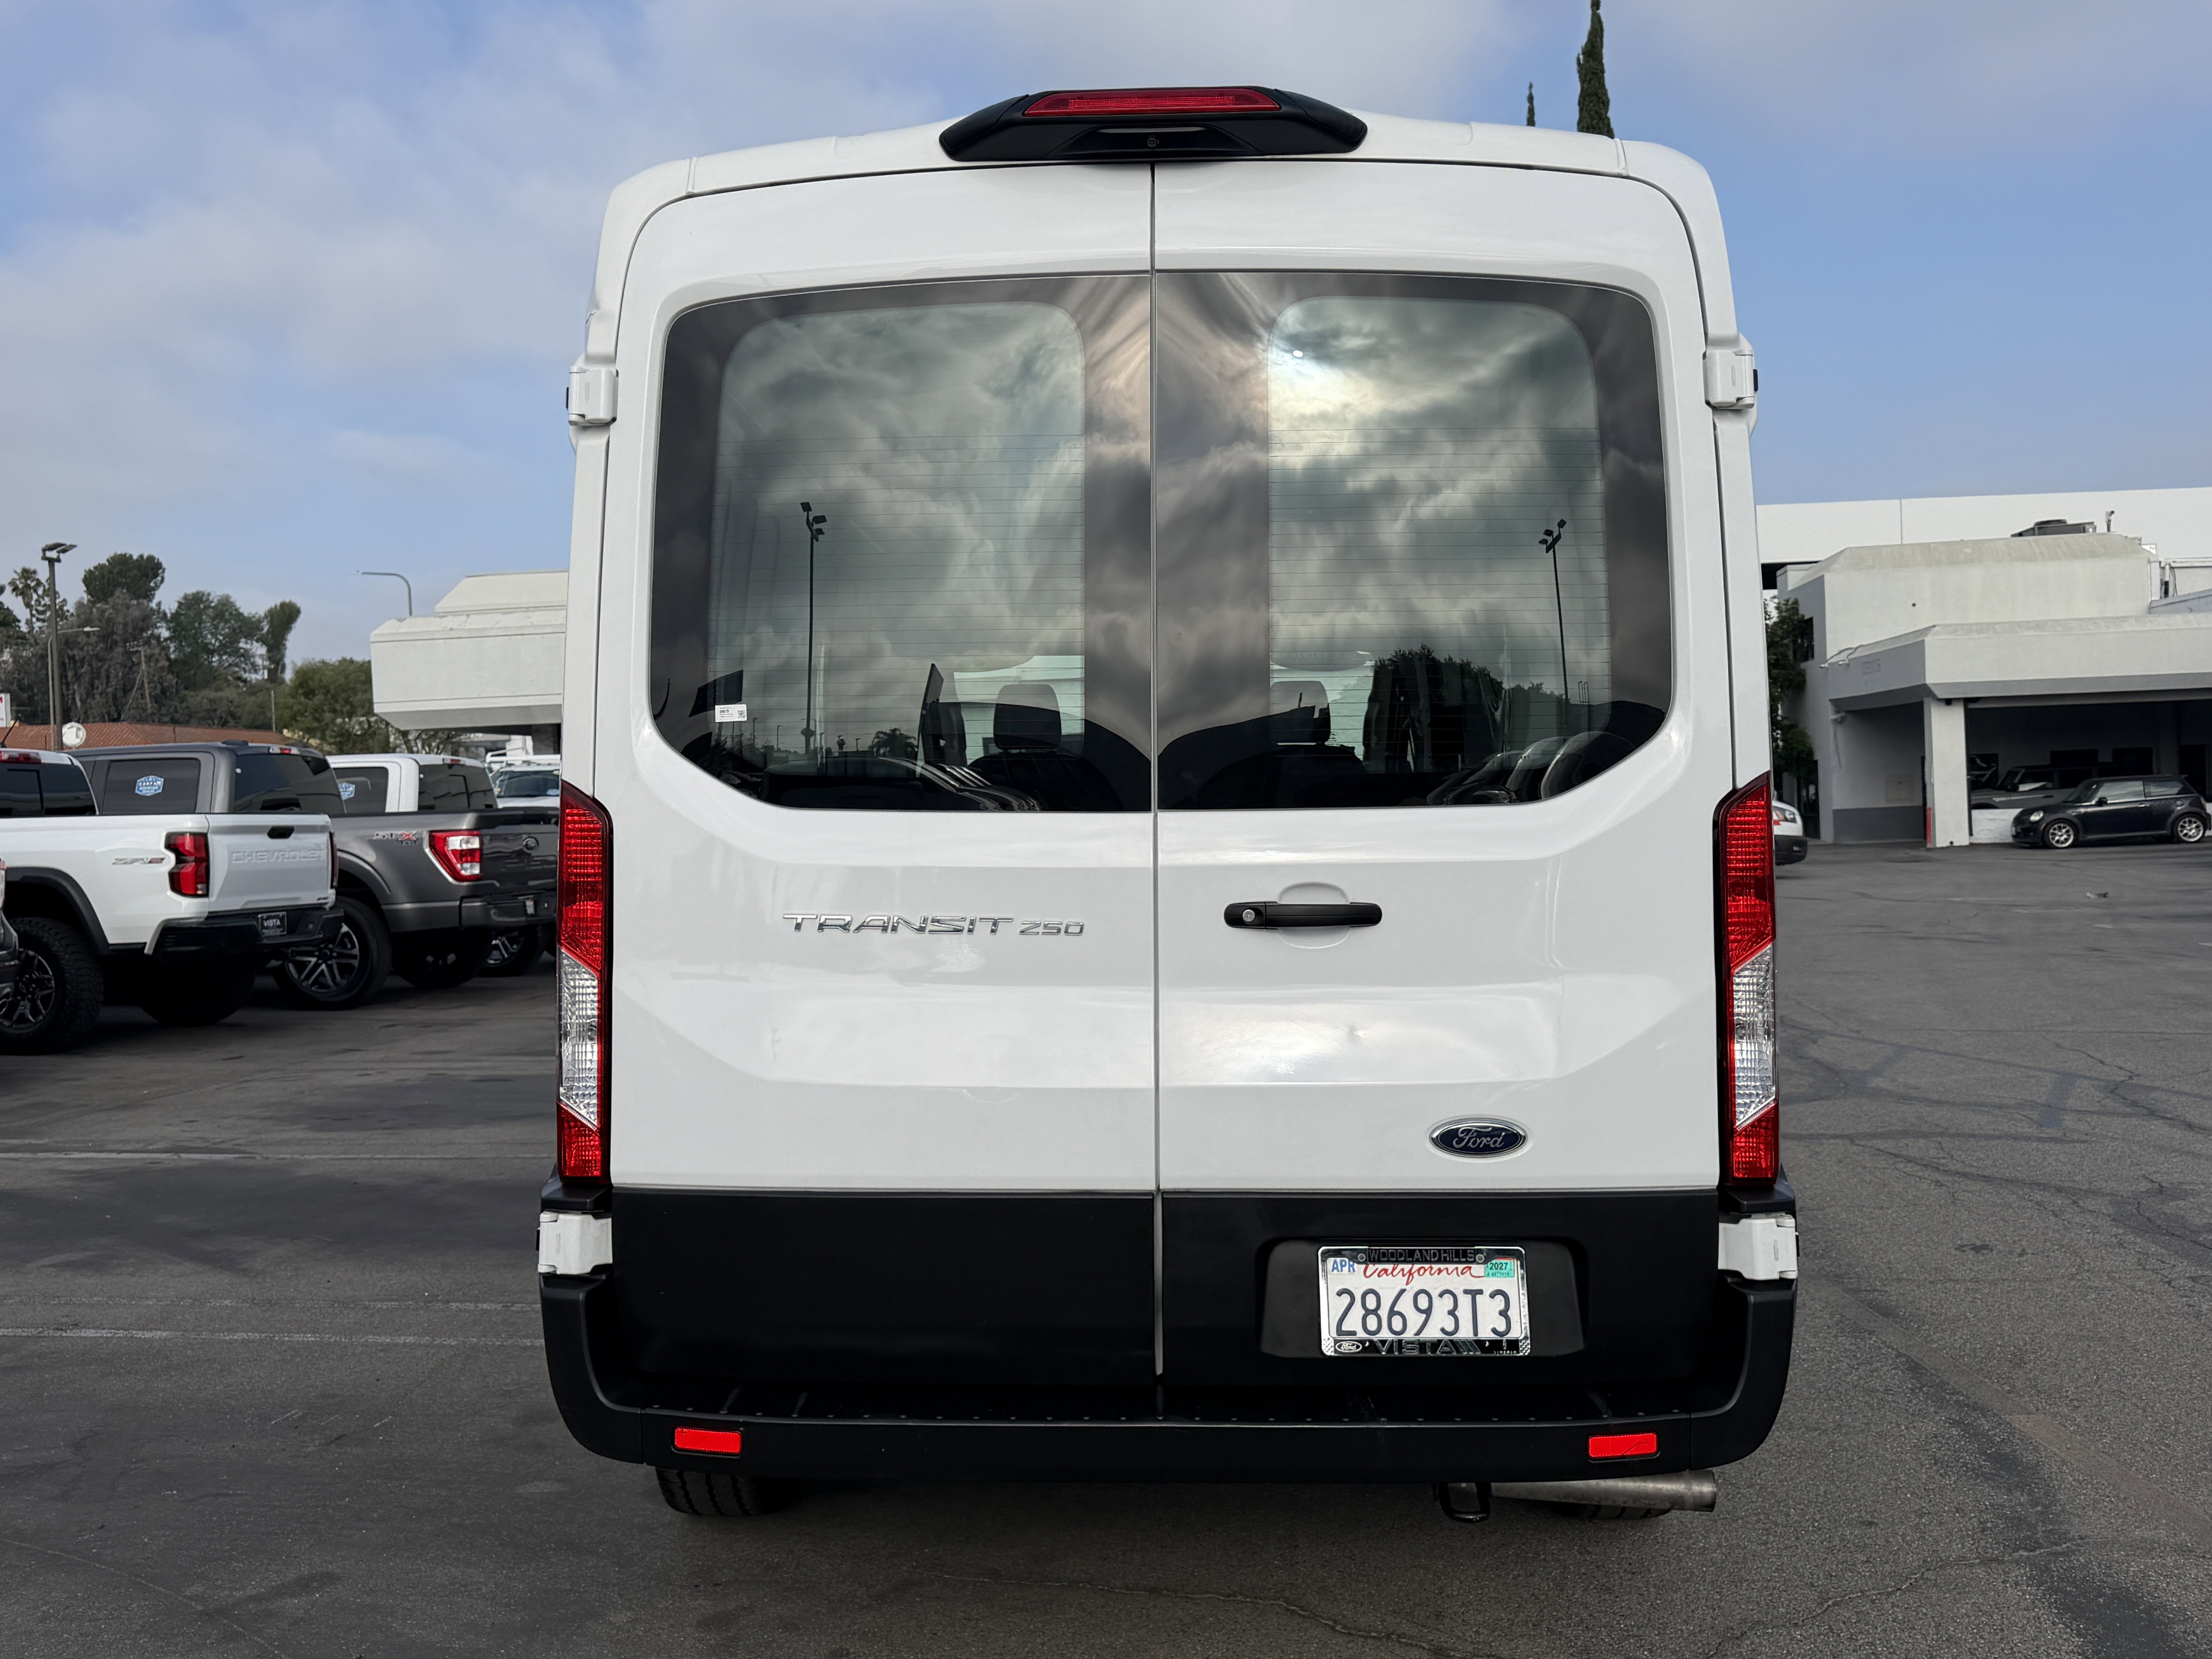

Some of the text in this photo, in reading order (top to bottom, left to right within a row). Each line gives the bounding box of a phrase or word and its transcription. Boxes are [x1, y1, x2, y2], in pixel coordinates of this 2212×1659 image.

[782, 914, 1085, 936] TRANSIT 250
[1453, 1127, 1505, 1149] Ford
[1369, 1249, 1474, 1262] WOODLAND HILLS
[1331, 1259, 1356, 1273] APR
[1363, 1264, 1484, 1286] California
[1489, 1262, 1508, 1270] 2027
[1336, 1288, 1511, 1336] 28693T3
[1373, 1339, 1457, 1355] VISTA
